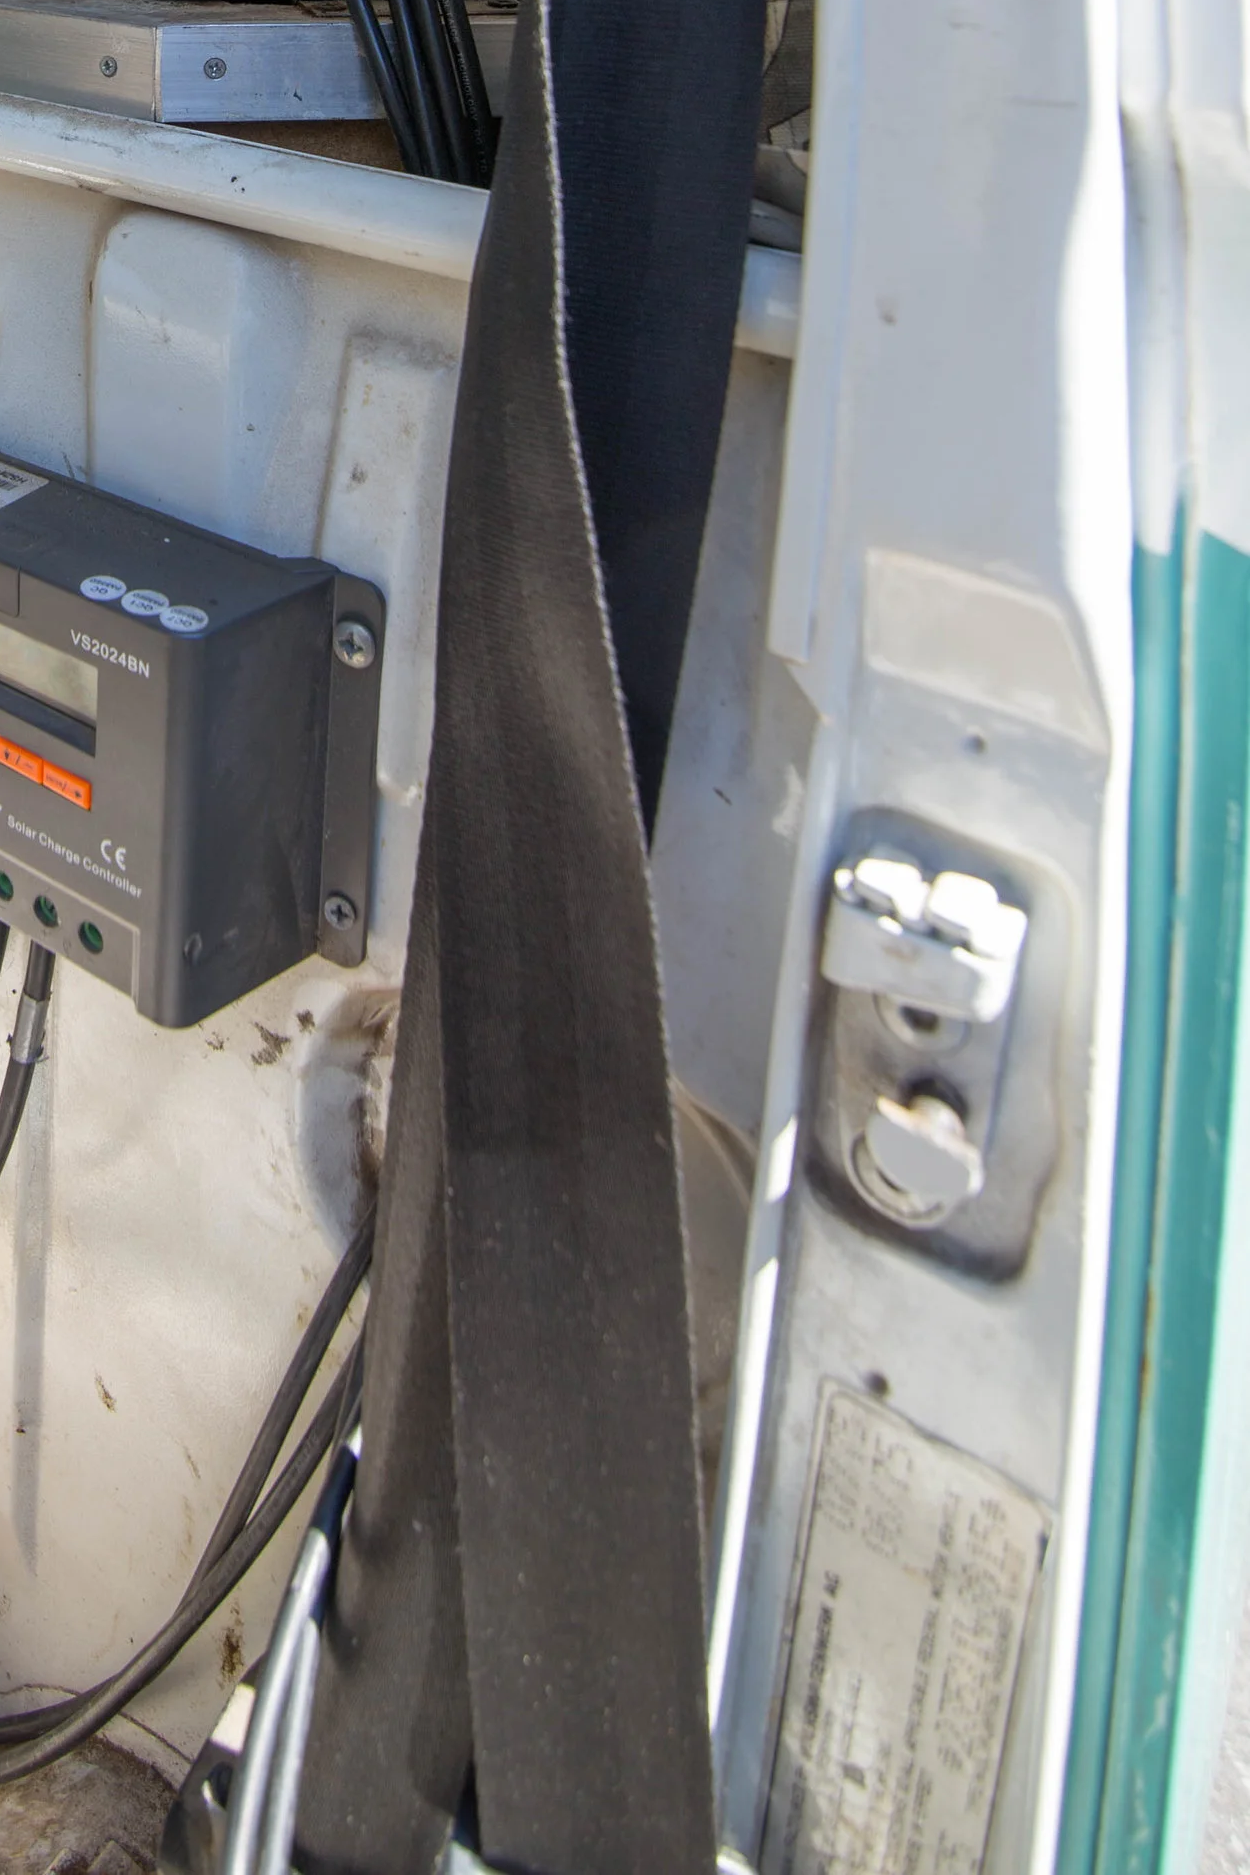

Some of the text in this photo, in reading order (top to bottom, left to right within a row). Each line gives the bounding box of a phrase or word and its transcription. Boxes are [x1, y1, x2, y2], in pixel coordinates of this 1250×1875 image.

[70, 628, 150, 678] VS2024BN
[7, 814, 142, 899] Solar Charge Controller
